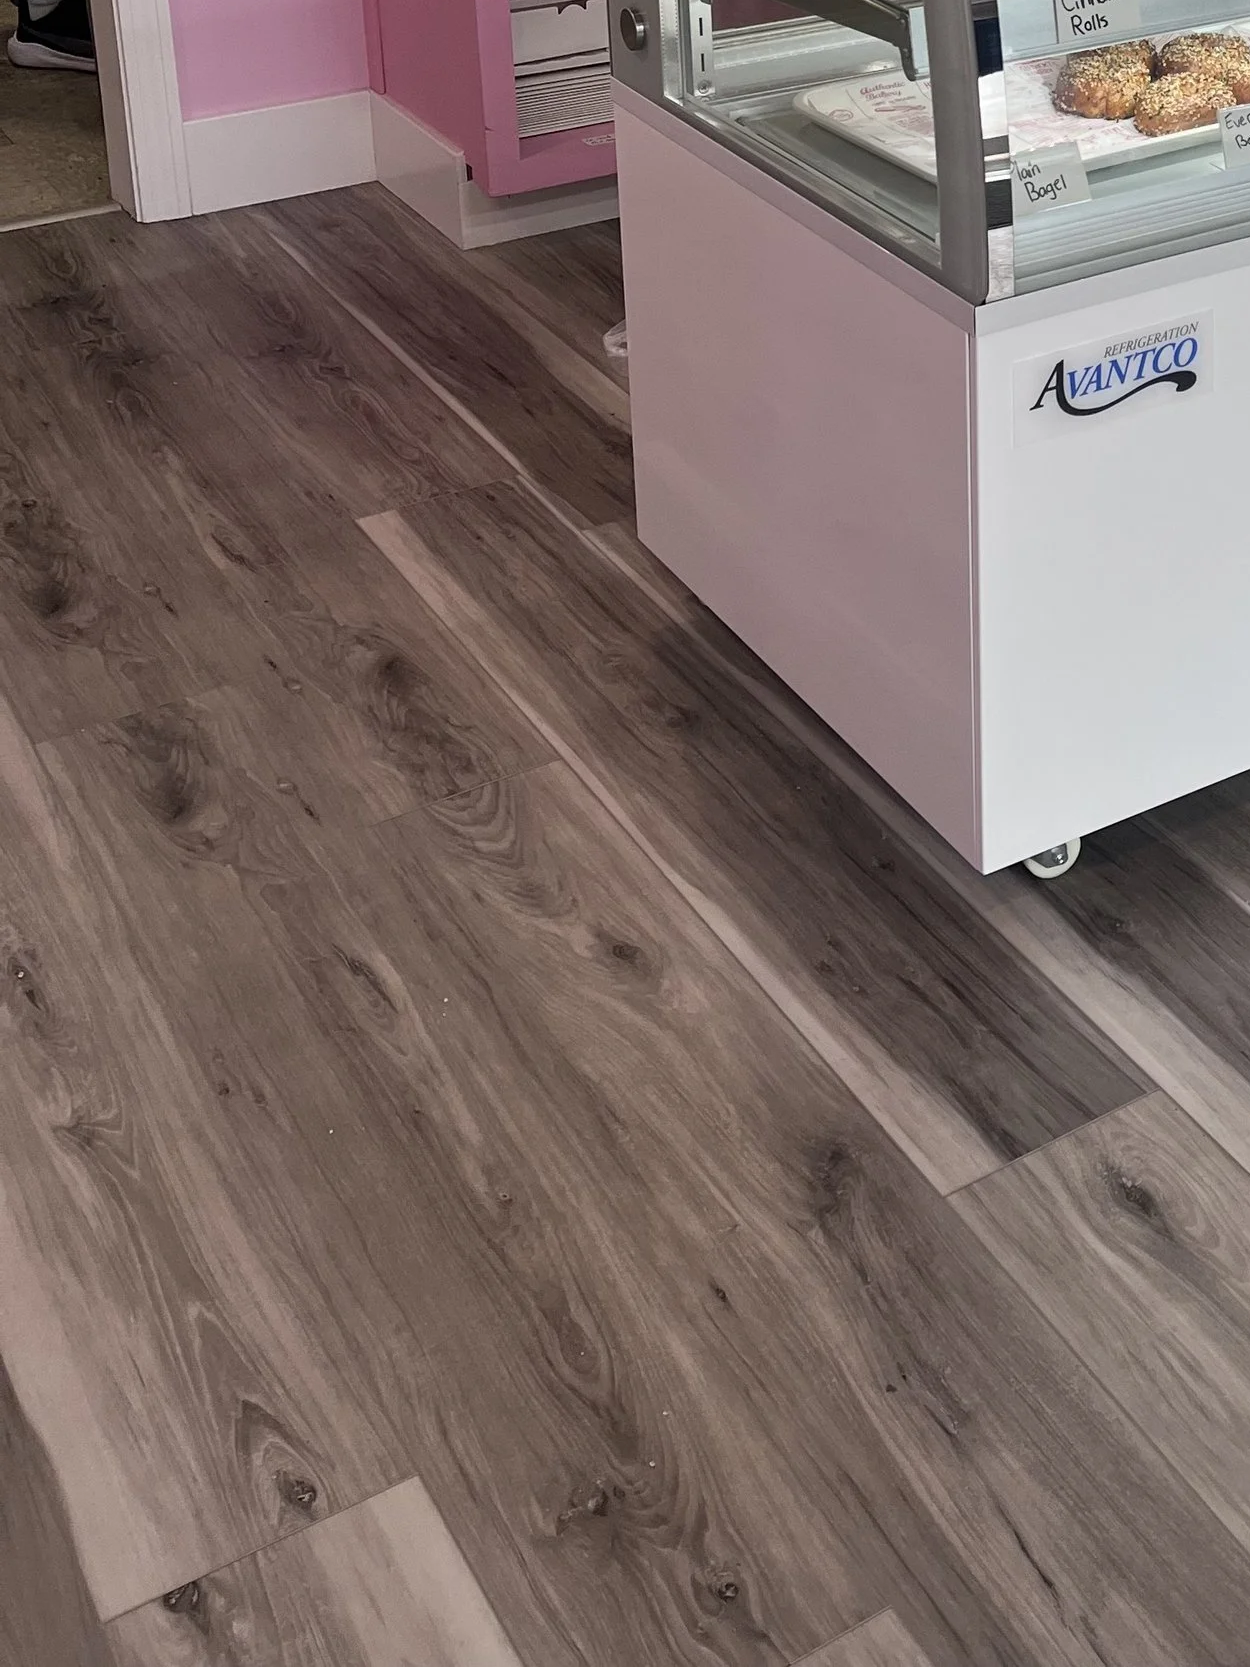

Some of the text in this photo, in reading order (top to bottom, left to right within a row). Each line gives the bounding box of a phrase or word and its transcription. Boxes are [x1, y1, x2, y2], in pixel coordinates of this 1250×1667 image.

[1070, 13, 1109, 36] Rolls
[1023, 173, 1068, 203] Bagel
[1103, 319, 1200, 359] REFRIGERATION
[1028, 337, 1199, 417] AVANTCO
